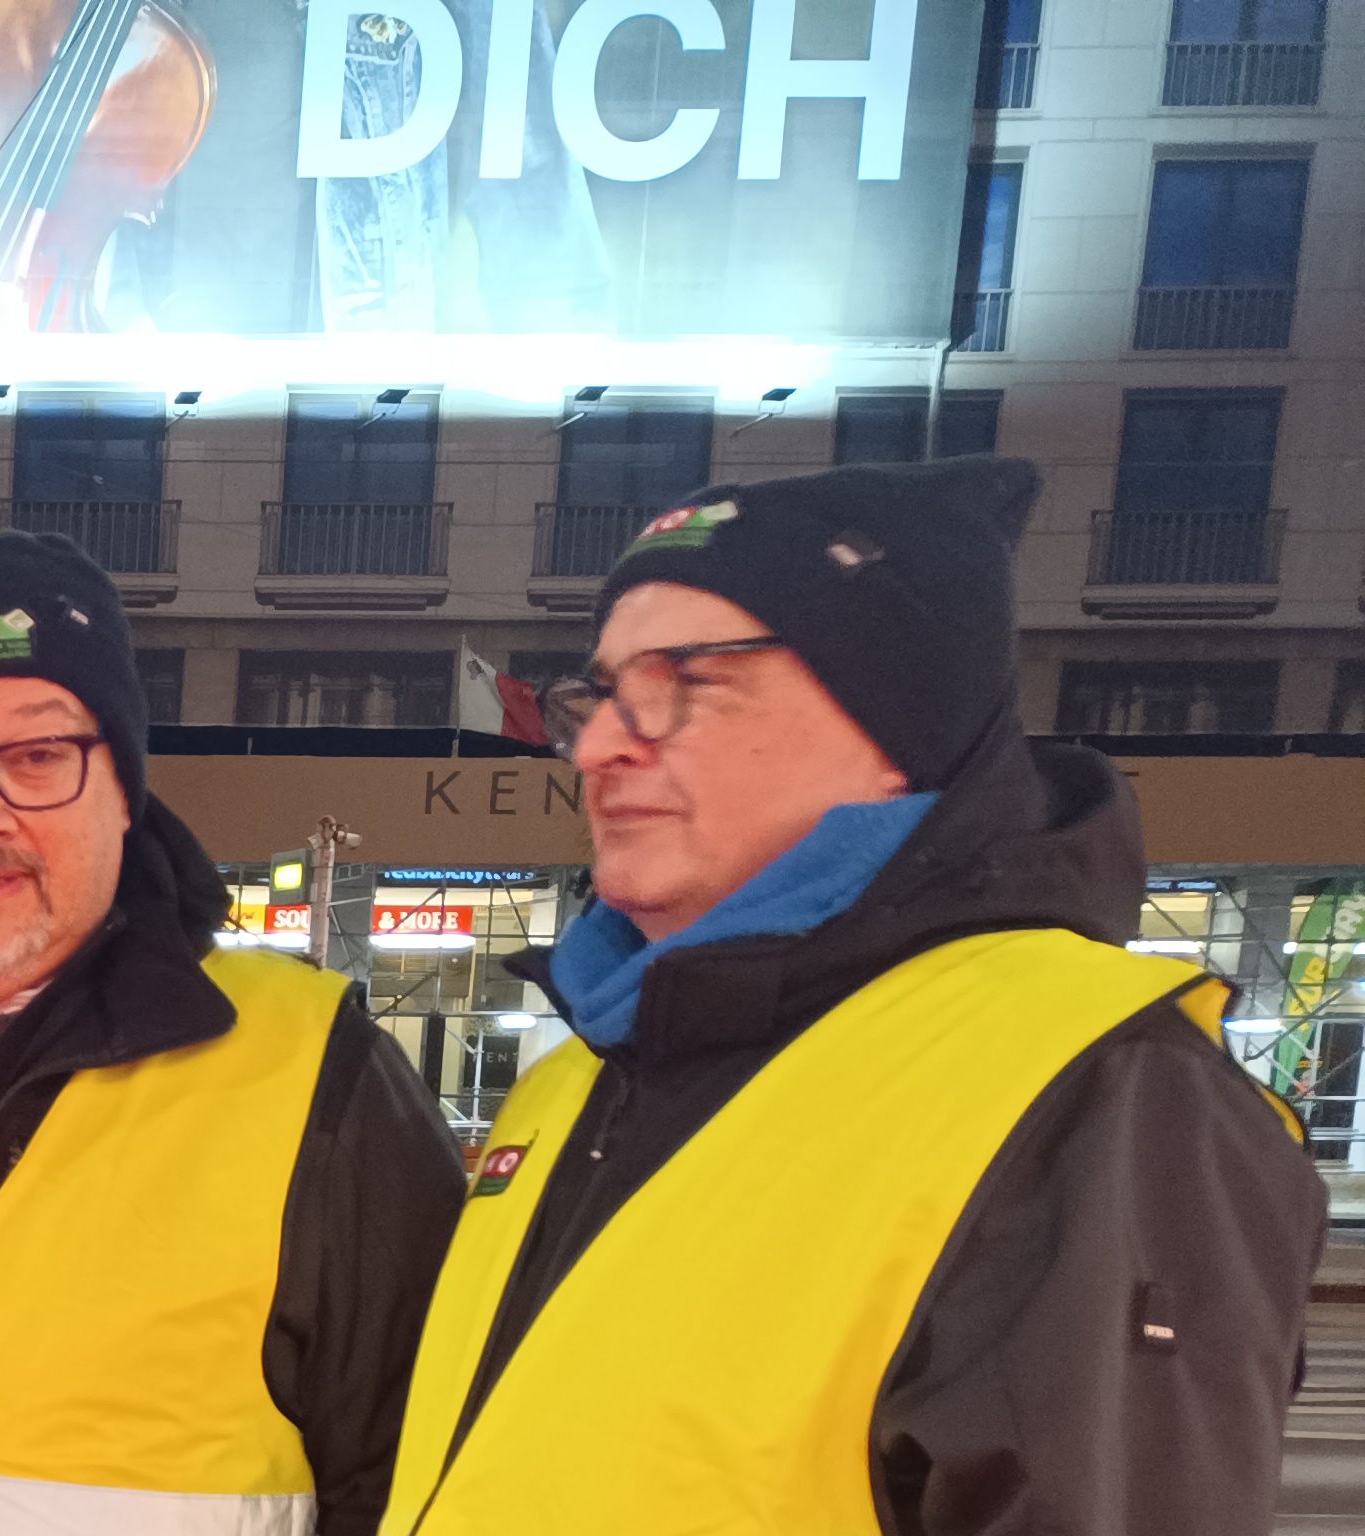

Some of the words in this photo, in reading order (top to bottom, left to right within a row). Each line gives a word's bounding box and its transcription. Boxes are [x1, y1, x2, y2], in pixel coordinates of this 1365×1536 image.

[297, 0, 917, 182] DICH
[424, 770, 582, 815] KEN
[378, 911, 395, 929] &
[399, 911, 459, 930] MORE
